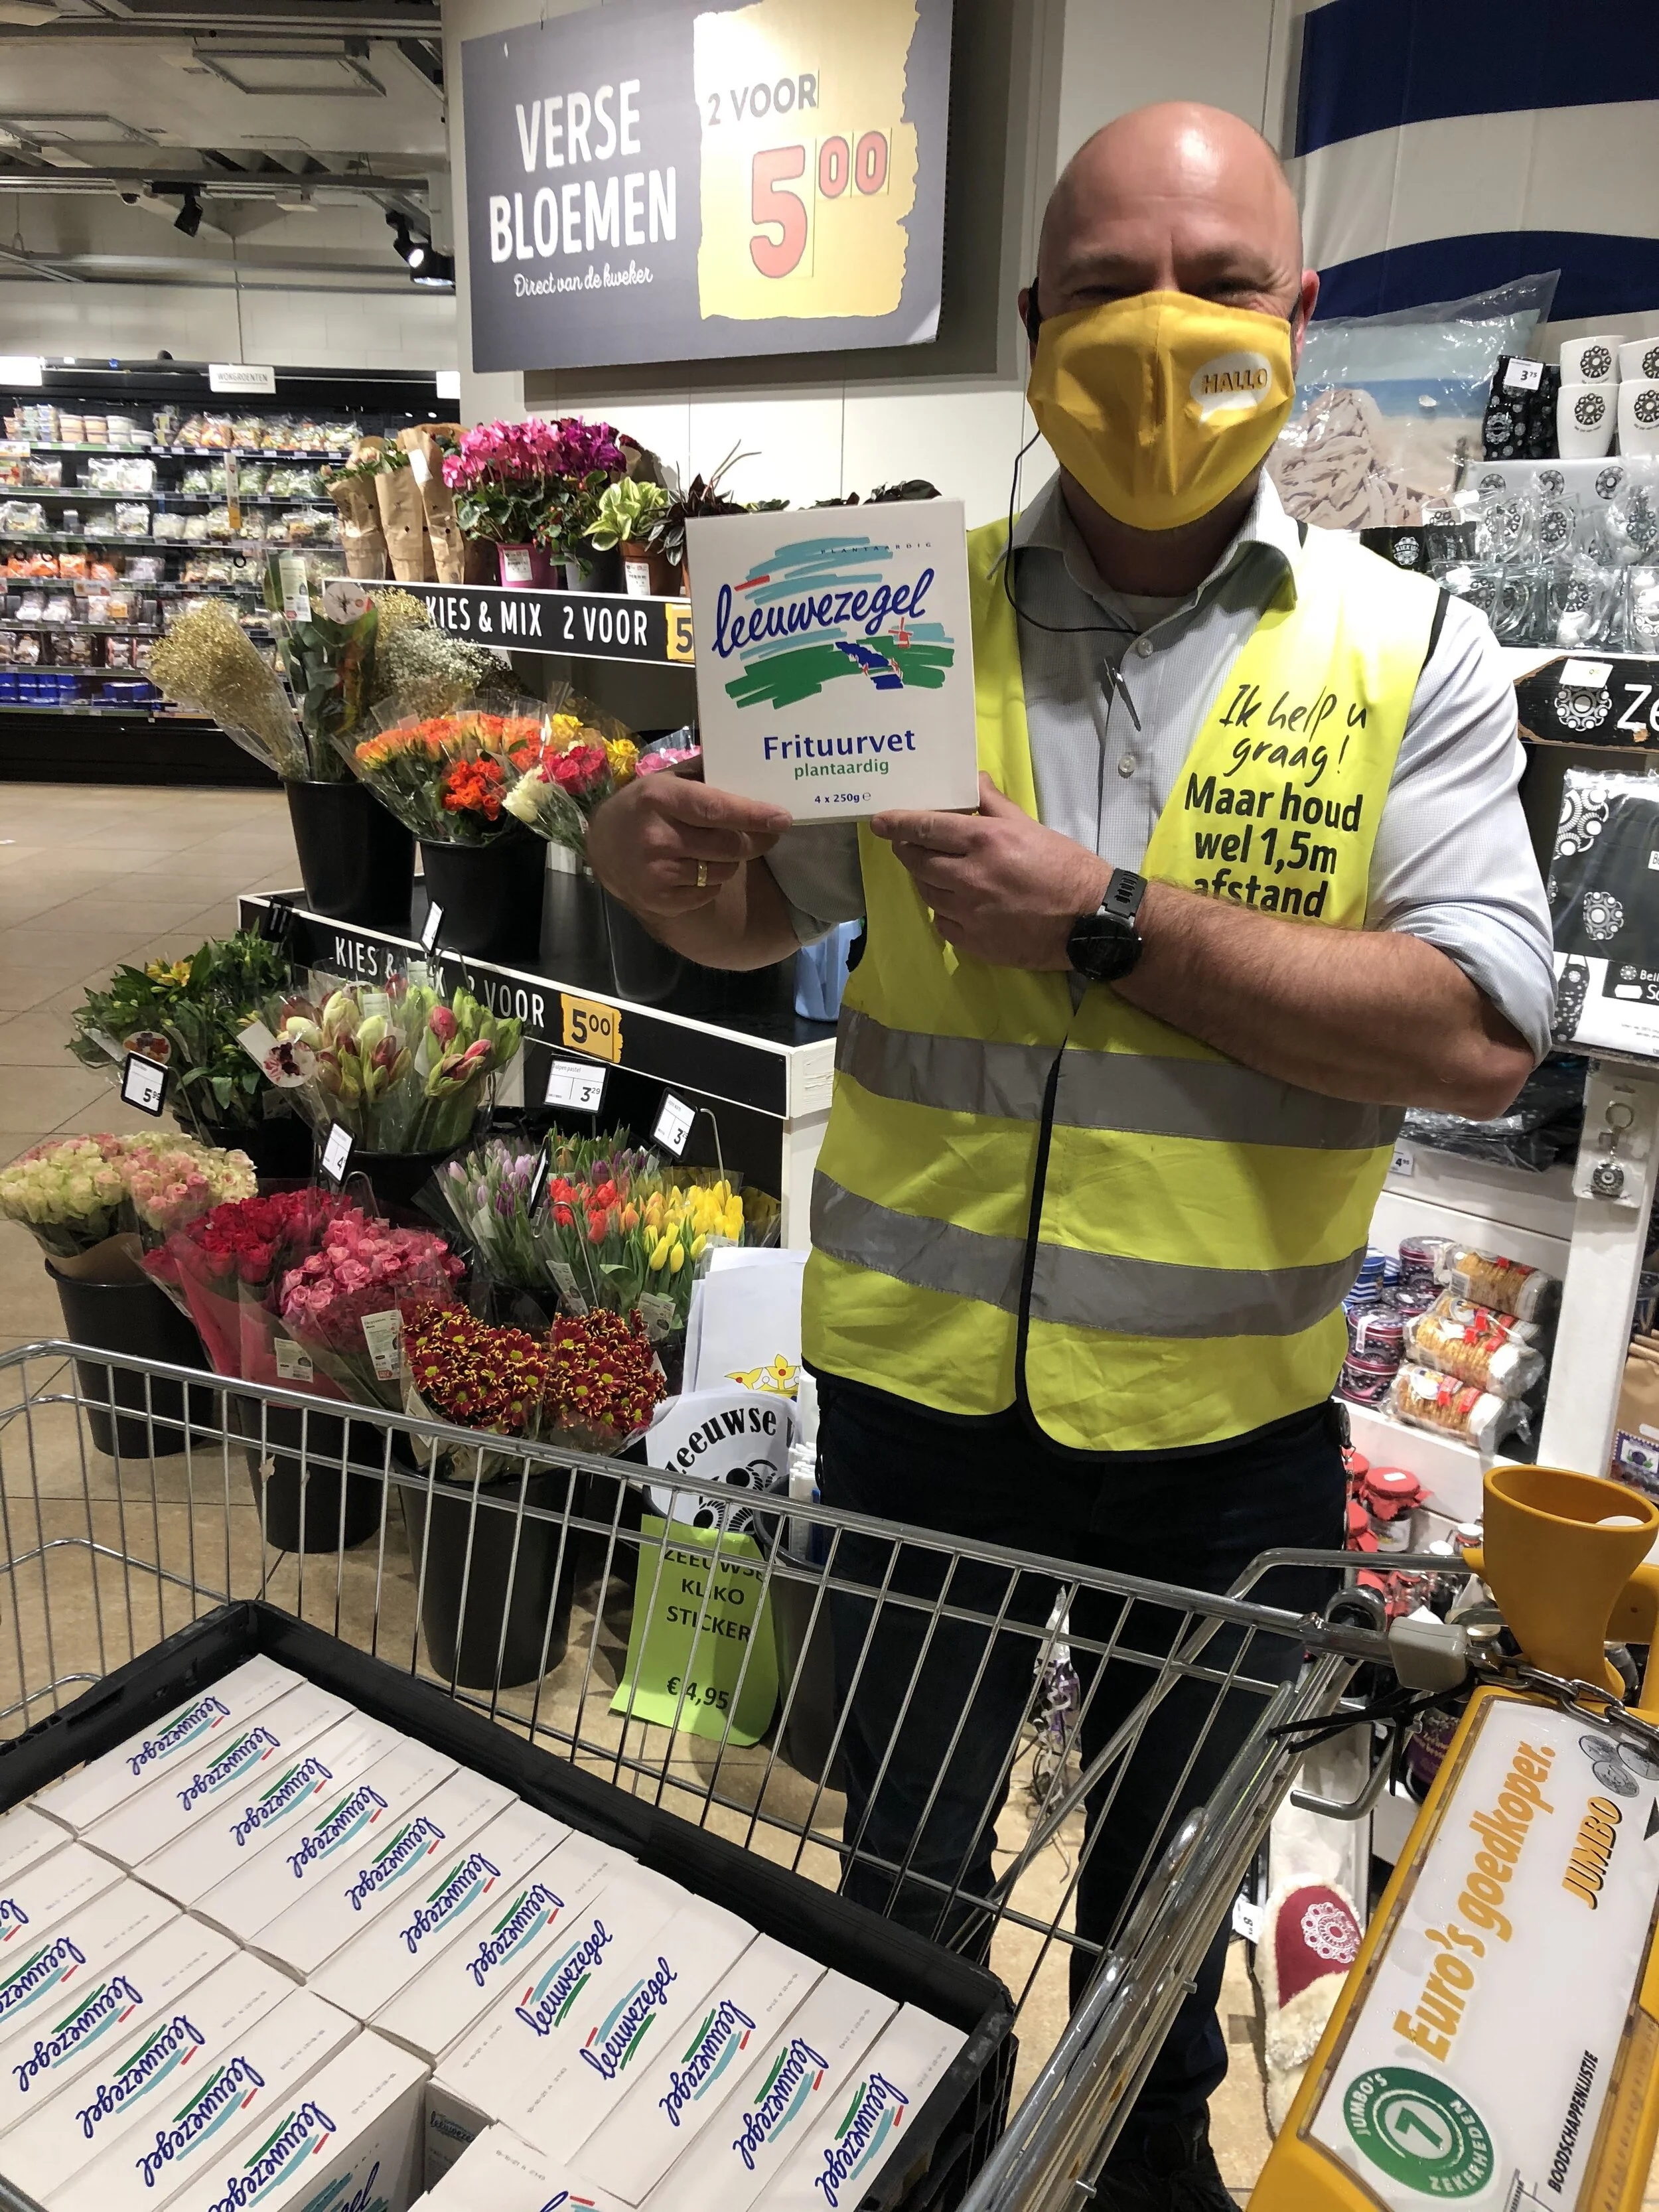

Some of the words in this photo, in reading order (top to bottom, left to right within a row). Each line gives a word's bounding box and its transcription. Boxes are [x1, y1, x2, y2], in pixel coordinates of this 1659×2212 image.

[516, 79, 641, 173] VERSE
[707, 93, 721, 126] 2
[730, 74, 817, 121] VOOR
[489, 167, 677, 263] BLOEMEN
[514, 272, 556, 297] Direct
[557, 275, 584, 293] van
[584, 265, 602, 289] de
[603, 259, 654, 287] kweker
[217, 373, 268, 382] WOKGROENTEN
[1202, 368, 1267, 394] HALLO
[821, 542, 932, 555] PLANTAARDIG
[425, 596, 470, 630] KIES
[479, 601, 493, 632] &
[501, 600, 542, 637] MIX
[563, 607, 575, 640] 2
[583, 606, 648, 646] VOOR
[711, 568, 934, 659] leeuwezegel
[764, 729, 916, 761] Frituurvet
[1220, 684, 1262, 727] Ik
[1267, 686, 1337, 743] help
[1347, 703, 1367, 729] u
[794, 759, 890, 780] plantaardig
[833, 793, 860, 803] 250g
[1185, 772, 1275, 818] Maar
[1280, 782, 1363, 832] houd
[1195, 824, 1253, 863] wel
[1261, 827, 1337, 875] 1,5m
[335, 936, 378, 976] KIES
[385, 953, 397, 980] &
[484, 980, 544, 1028] VOOR
[666, 1605, 752, 1643] STICKER
[682, 1578, 745, 1605] KLKO
[126, 1696, 230, 1775] leeuwezegel
[667, 1676, 681, 1696] €
[685, 1682, 729, 1710] 4,95
[177, 1727, 281, 1810] leeuwezegel
[229, 1757, 332, 1846] leeuwezegel
[287, 1785, 388, 1878] leeuwezegel
[344, 1816, 445, 1911] leeuwezegel
[1561, 1796, 1623, 1910] JUMBO
[399, 1852, 501, 1953] leeuwezegel
[466, 1883, 565, 1987] leeuwezegel
[1392, 1923, 1485, 2063] Euro's
[1457, 1741, 1555, 1943] goedkoper.
[515, 1919, 613, 2037] leeuwezegel
[579, 1956, 678, 2081] leeuwezegel
[12, 1976, 143, 2092] leeuwezegel
[76, 2015, 206, 2139] leeuwezegel
[659, 1999, 756, 2127] leeuwezegel
[135, 2056, 265, 2187] leeuwezegel
[733, 2037, 829, 2170] leeuwezegel
[815, 2073, 909, 2208] leeuwezegel
[1350, 2073, 1388, 2137] JUMBO'S
[1429, 2099, 1488, 2192] ZEKERHEDEN
[208, 2101, 336, 2212] leeuwezege
